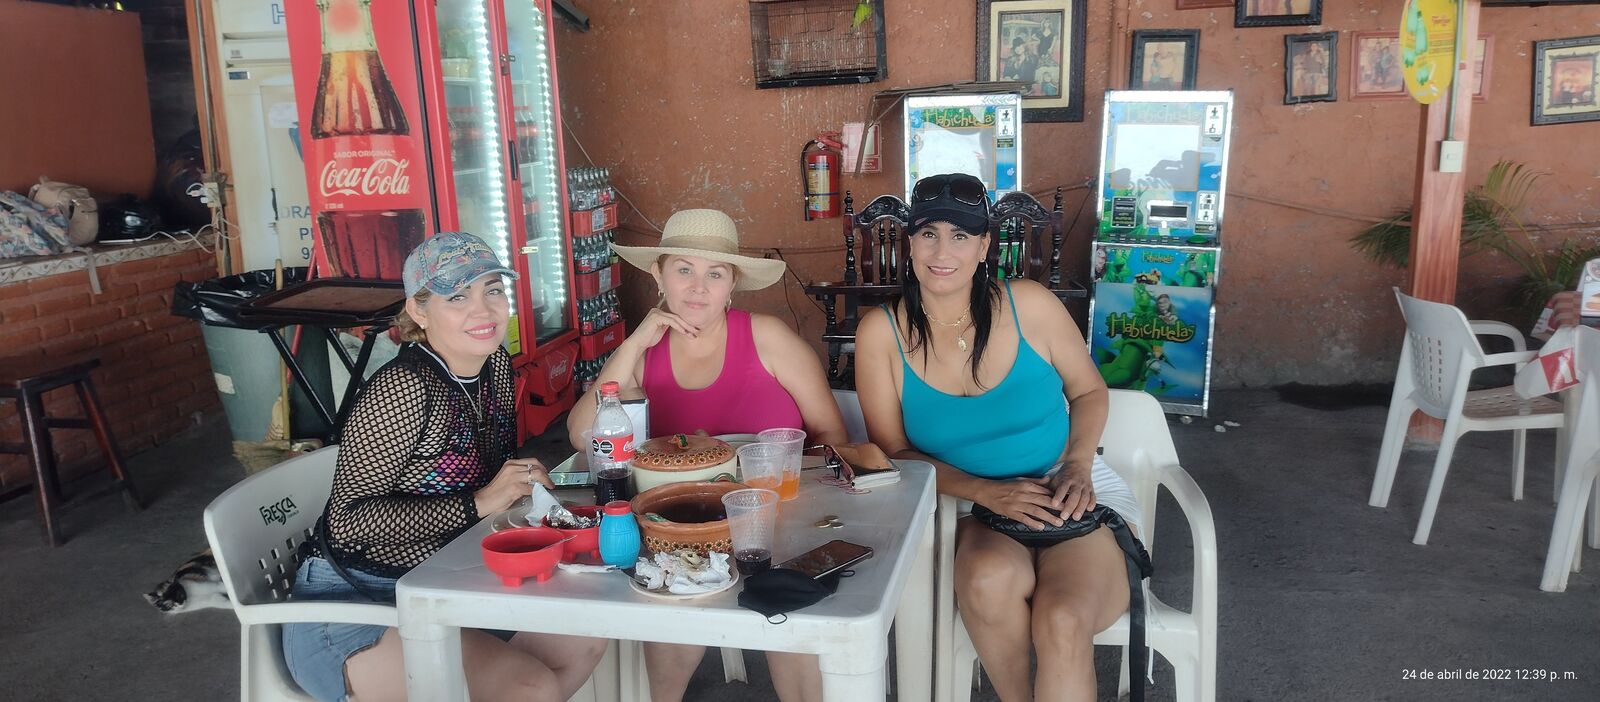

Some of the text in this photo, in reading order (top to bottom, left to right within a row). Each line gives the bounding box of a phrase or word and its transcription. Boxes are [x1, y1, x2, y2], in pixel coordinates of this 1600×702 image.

[333, 151, 357, 159] SABOR
[320, 159, 410, 197] Coca-Cola
[1110, 314, 1195, 342] Habichuelas
[259, 497, 297, 526] FRESCA
